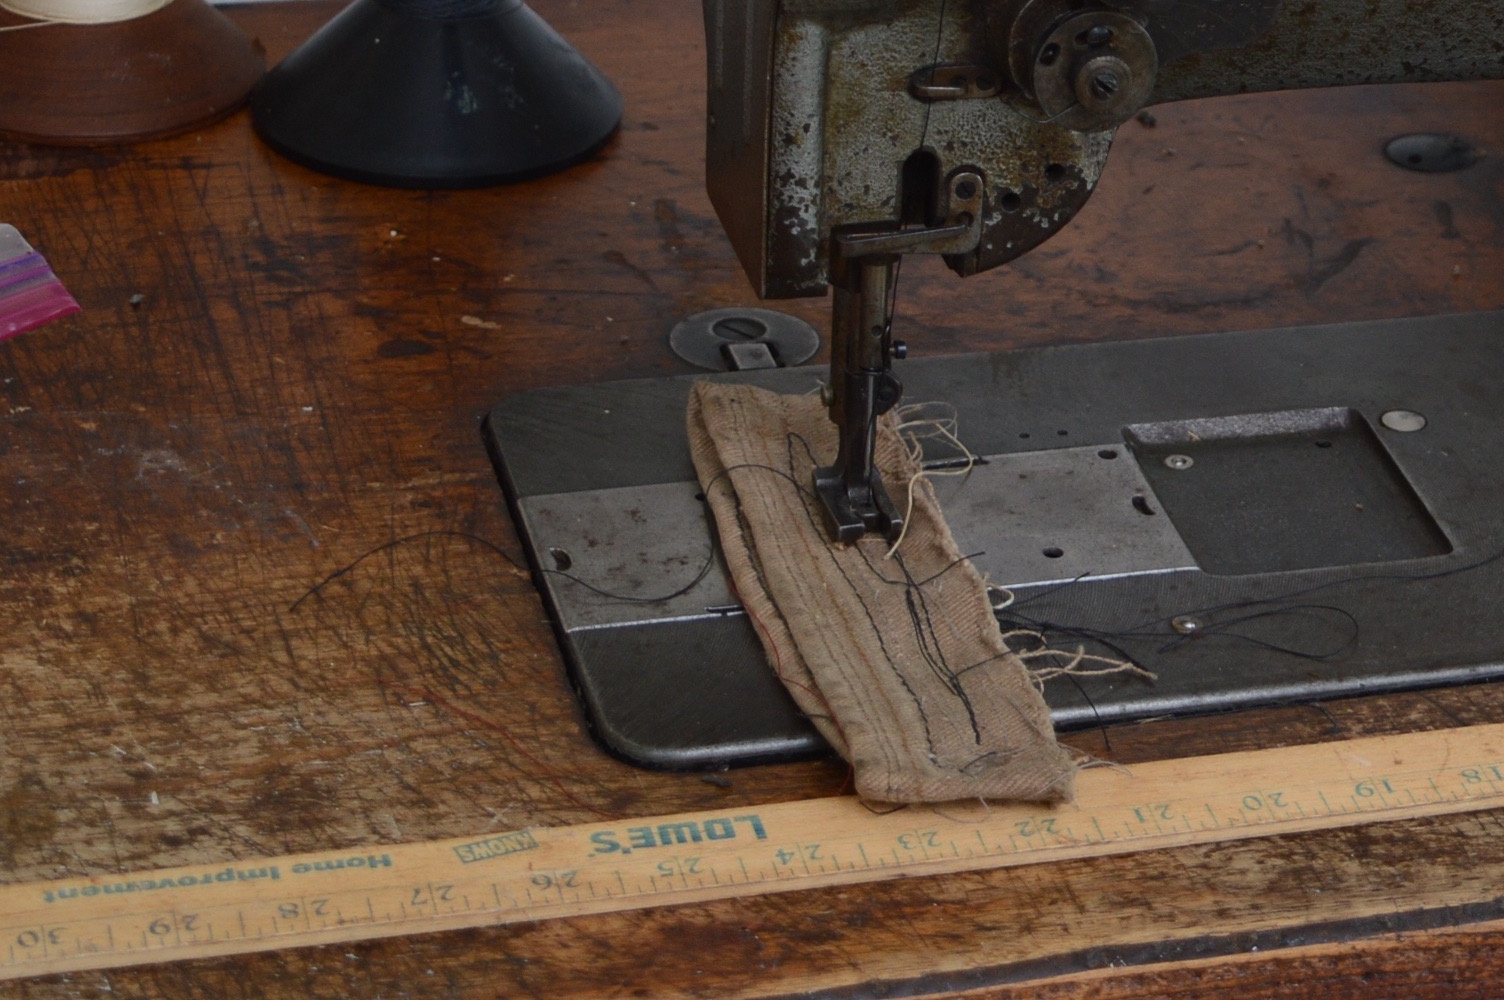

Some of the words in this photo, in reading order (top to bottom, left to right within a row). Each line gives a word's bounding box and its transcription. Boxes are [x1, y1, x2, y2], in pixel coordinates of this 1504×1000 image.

[1461, 766, 1504, 783] 18
[1354, 778, 1399, 797] 19
[1242, 792, 1288, 811] 20
[1132, 804, 1174, 823] 21
[588, 814, 768, 855] LOWE'S
[1014, 818, 1057, 837] 22
[455, 831, 535, 863] KNOWS
[898, 831, 942, 851] 23
[292, 854, 393, 875] Home
[775, 844, 825, 865] 24
[656, 857, 702, 876] 25
[43, 864, 282, 903] Improvement
[531, 871, 582, 889] 26
[411, 885, 455, 906] 27
[278, 899, 331, 919] 28
[149, 915, 200, 935] 29
[17, 927, 67, 948] 30
